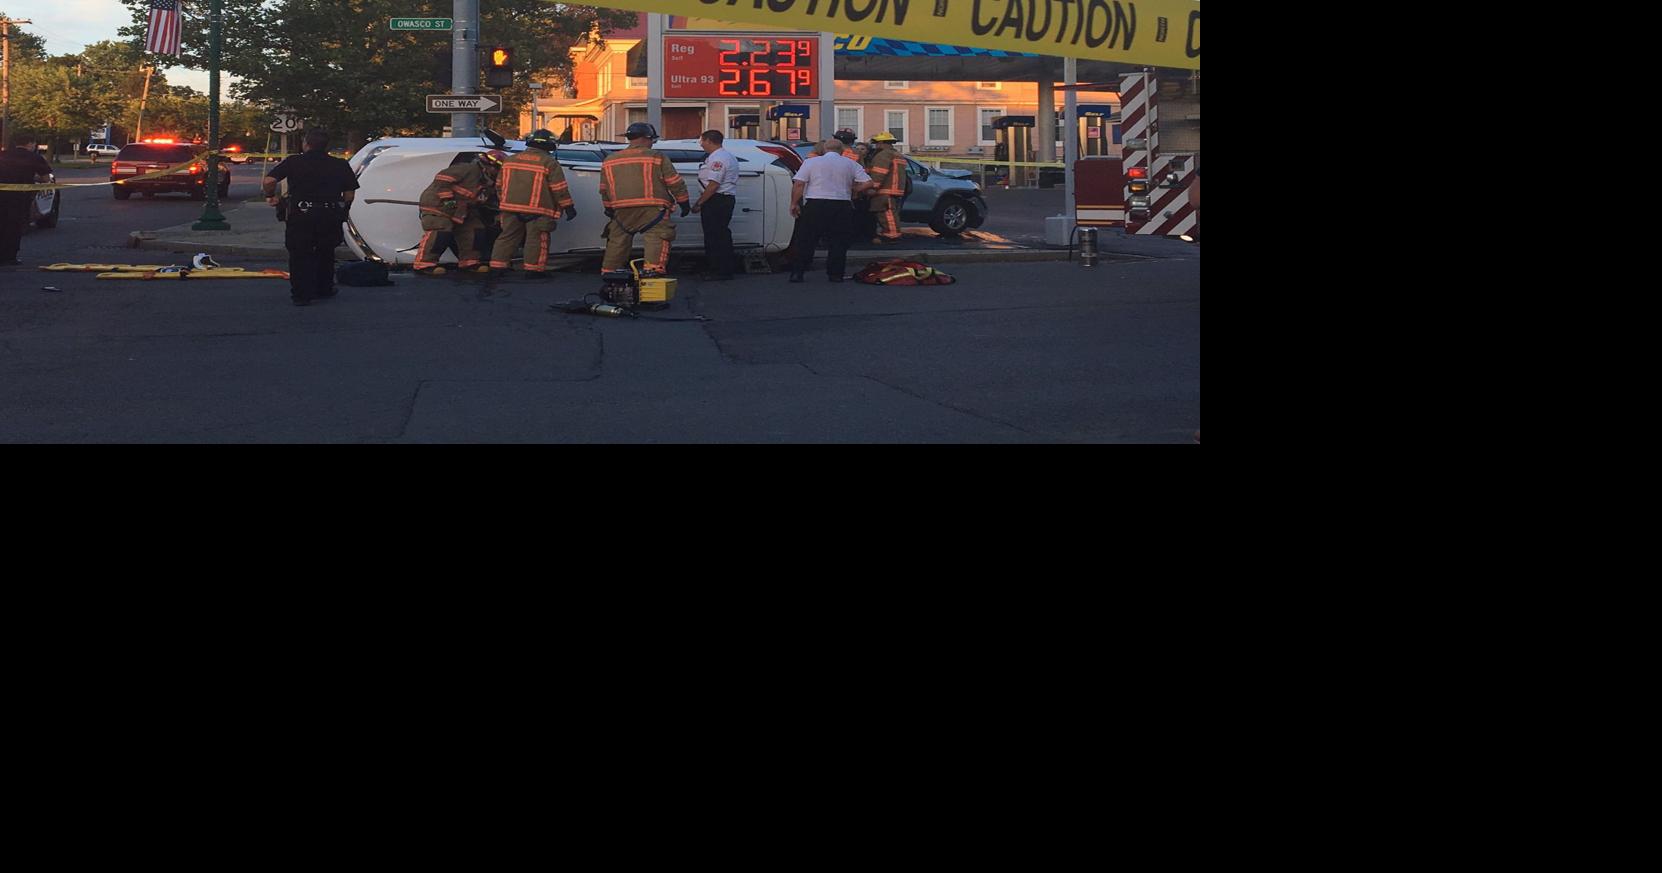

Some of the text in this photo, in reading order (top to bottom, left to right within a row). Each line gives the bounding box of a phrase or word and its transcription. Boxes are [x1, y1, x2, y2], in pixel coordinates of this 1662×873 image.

[397, 20, 445, 28] OWASCO ST
[971, 0, 1136, 50] CAUTION
[671, 43, 695, 55] Reg
[671, 75, 697, 83] Ultra
[700, 75, 715, 83] 93
[271, 118, 296, 129] 20
